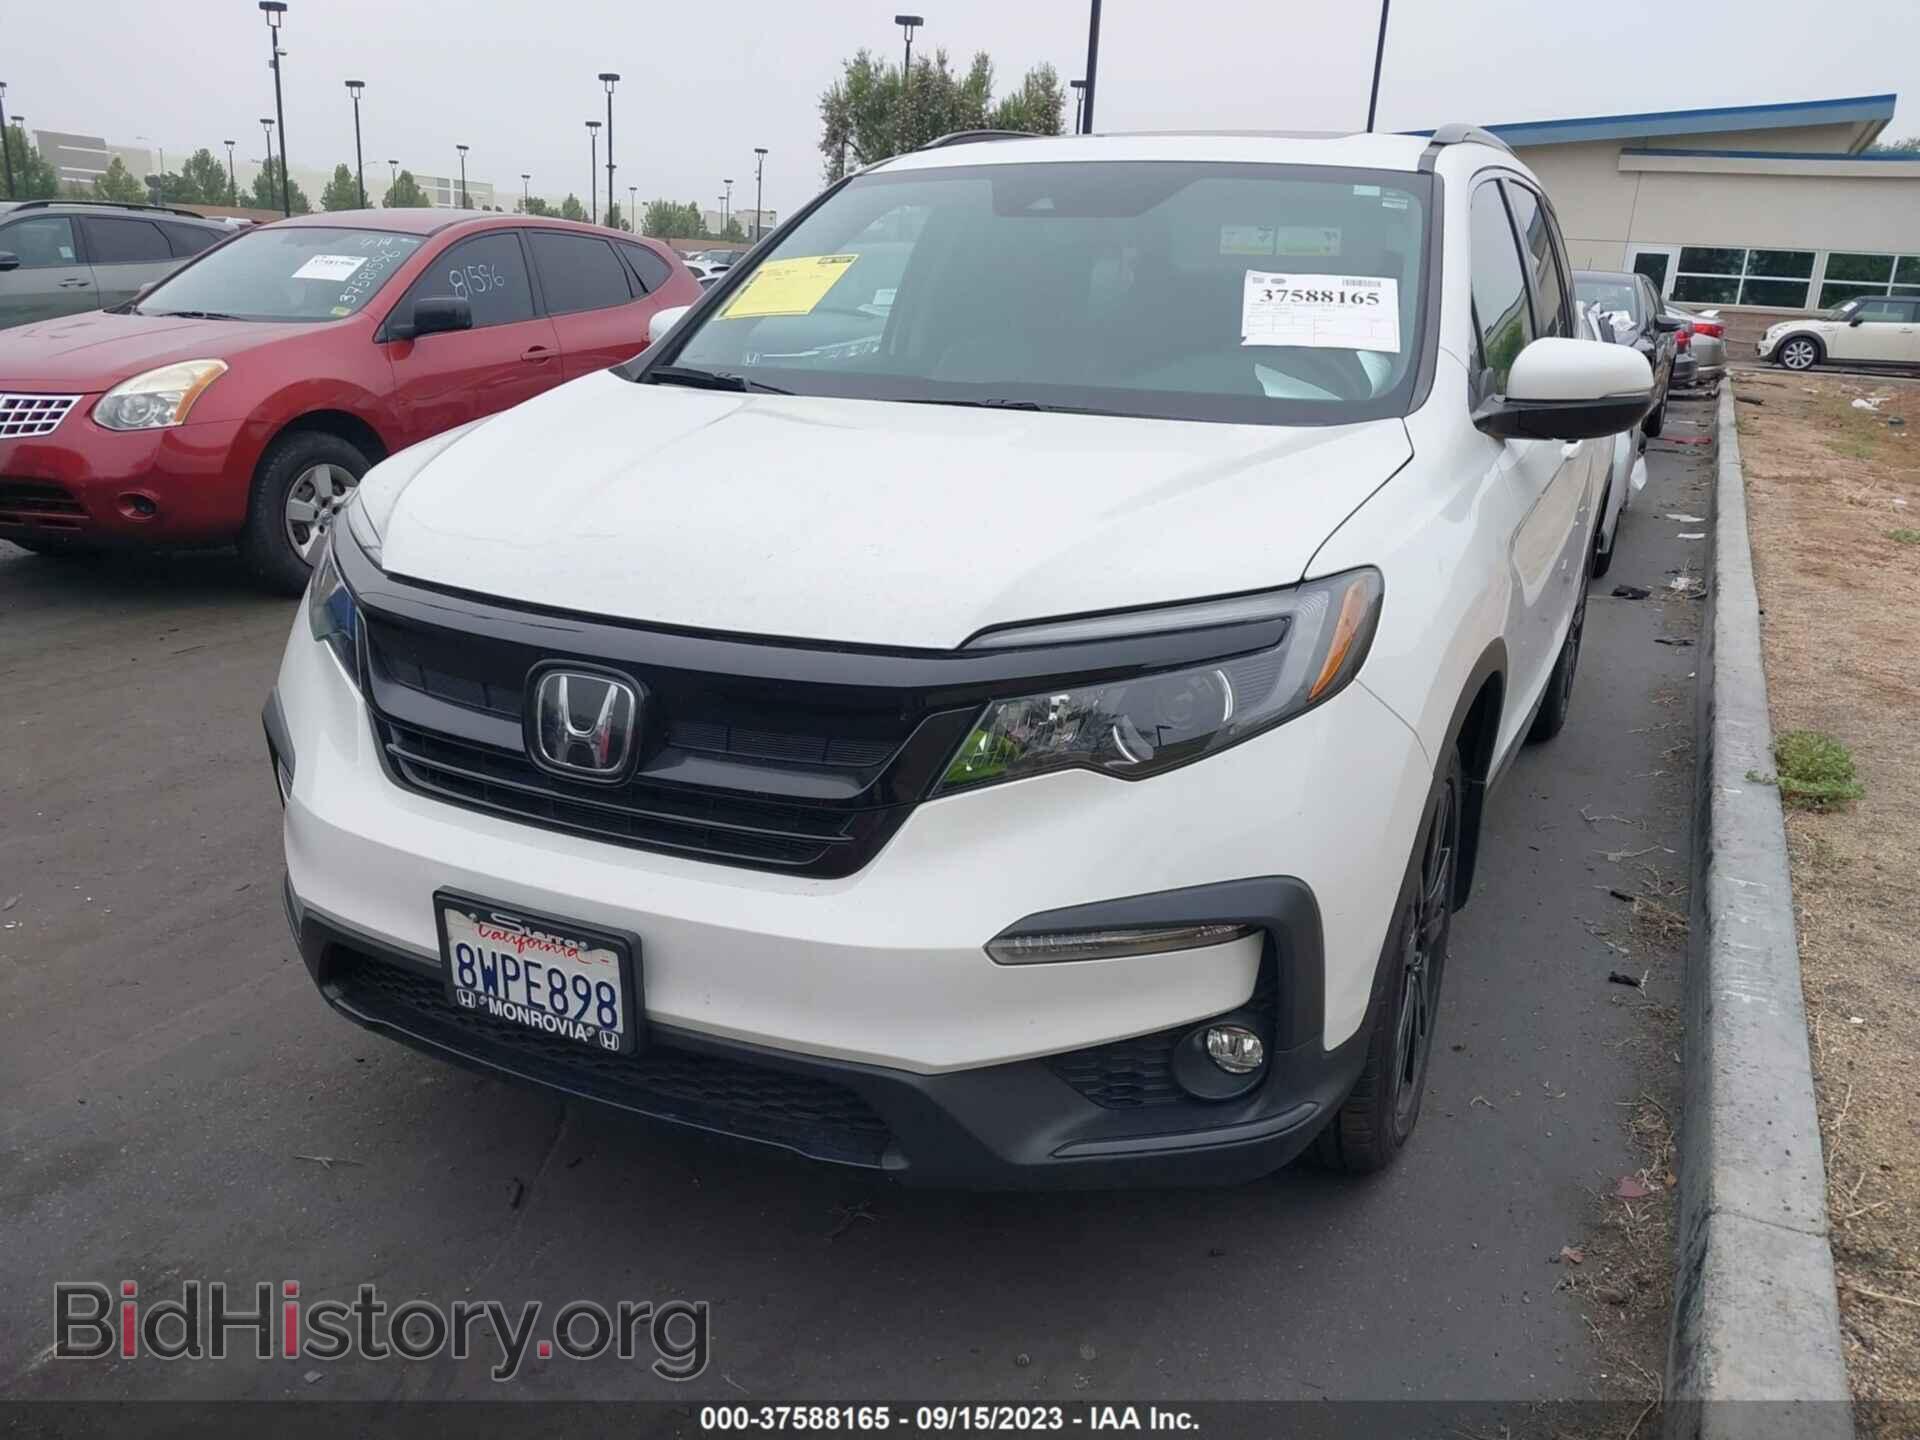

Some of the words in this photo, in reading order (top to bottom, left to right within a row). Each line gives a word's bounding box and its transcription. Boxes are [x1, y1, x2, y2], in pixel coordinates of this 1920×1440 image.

[448, 263, 506, 302] 81596
[1259, 288, 1381, 306] 37588165
[455, 942, 618, 1032] 8WPE898
[488, 997, 588, 1042] MONROVIA
